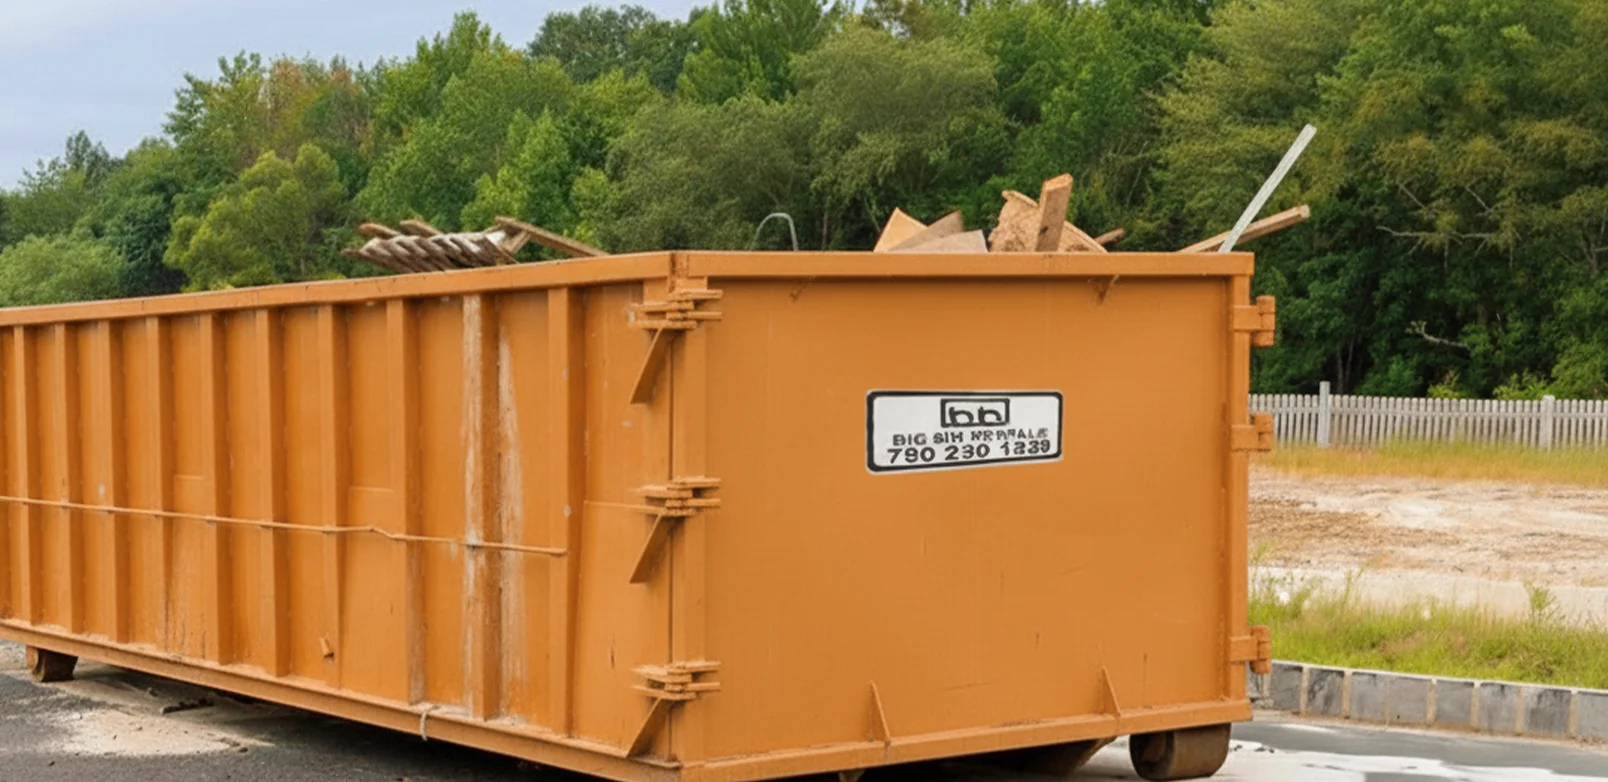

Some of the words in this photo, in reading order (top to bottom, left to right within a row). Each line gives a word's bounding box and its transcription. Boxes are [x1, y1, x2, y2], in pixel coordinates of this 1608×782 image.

[892, 433, 927, 446] BIG
[887, 446, 935, 464] 790
[944, 443, 990, 461] 230
